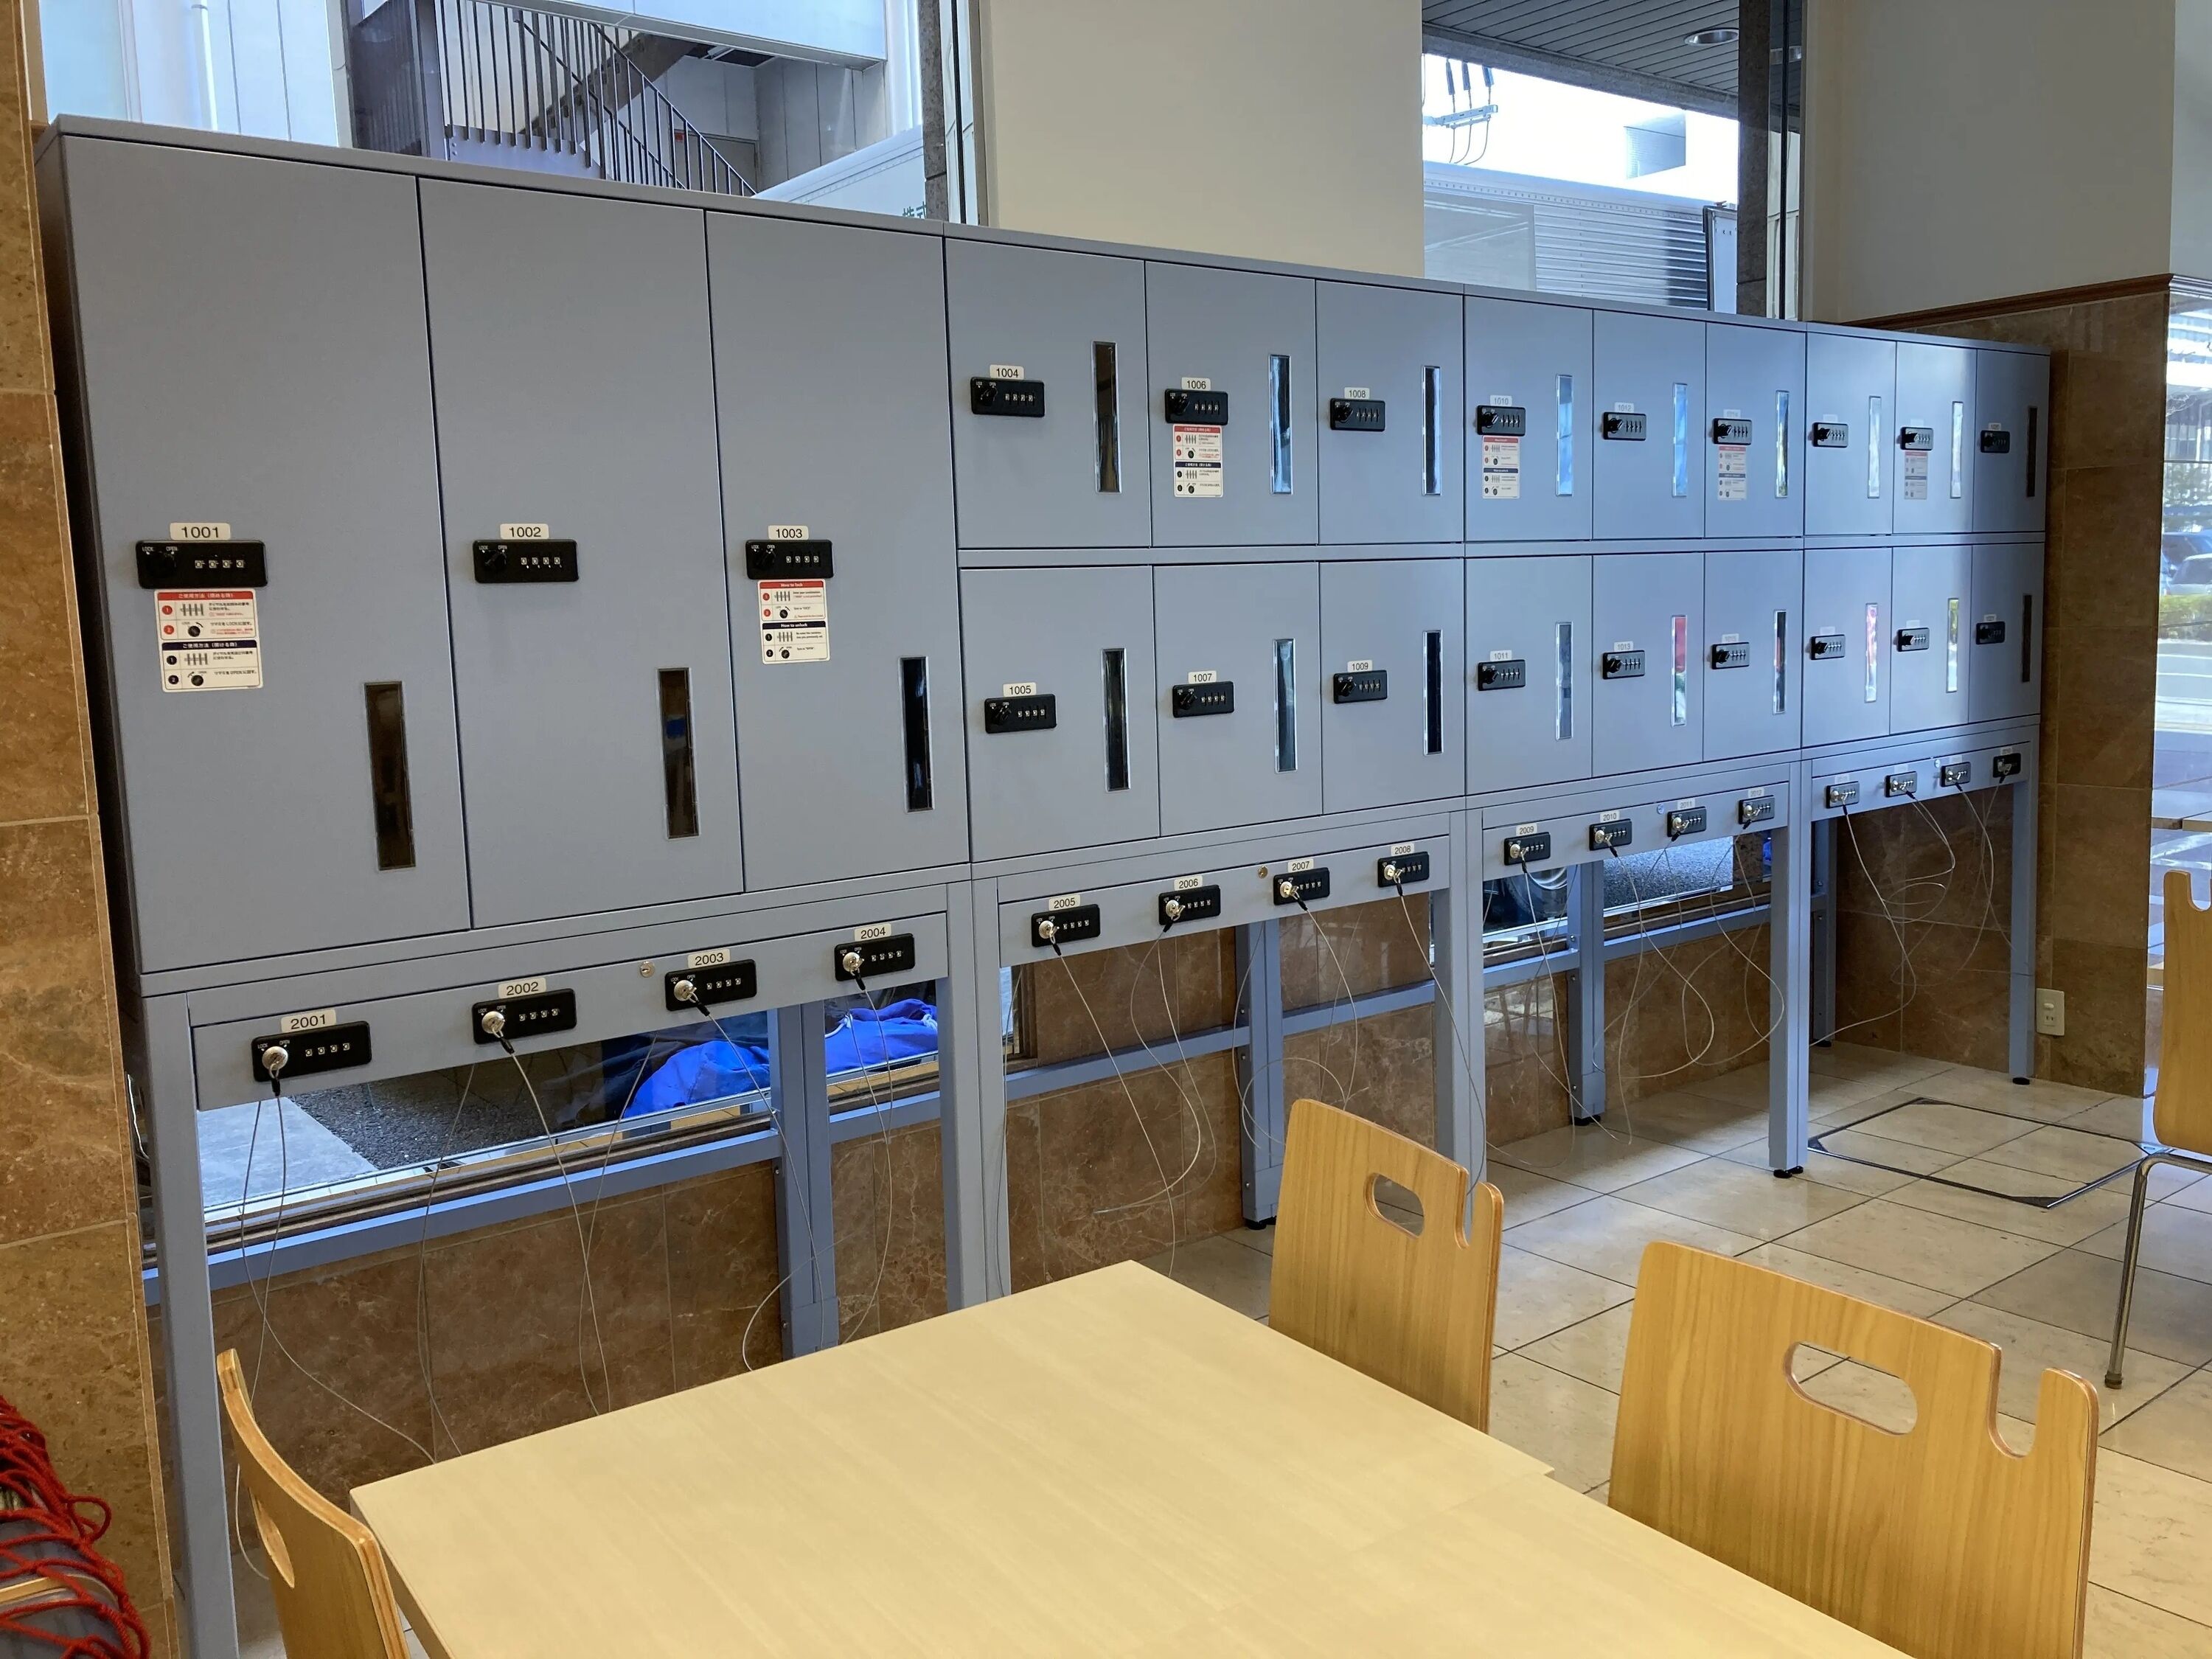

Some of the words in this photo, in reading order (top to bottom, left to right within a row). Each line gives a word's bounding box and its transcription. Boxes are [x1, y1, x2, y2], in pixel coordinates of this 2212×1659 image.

[996, 368, 1018, 378] 1004
[1187, 380, 1206, 389] 1006
[181, 526, 219, 538] 1001
[509, 526, 541, 538] 1002
[776, 529, 803, 538] 1003
[1352, 662, 1368, 670] 1009
[1194, 673, 1212, 682] 1007
[1009, 685, 1031, 695] 1005
[1603, 813, 1617, 821] 2010
[1519, 826, 1534, 835] 2009
[1394, 846, 1411, 855] 2008
[1292, 861, 1310, 871] 2007
[1178, 878, 1198, 889] 2006
[1054, 897, 1076, 908] 2005
[860, 927, 886, 939] 2004
[695, 953, 724, 966] 2003
[506, 981, 539, 996] 2002
[291, 1015, 326, 1029] 2001
